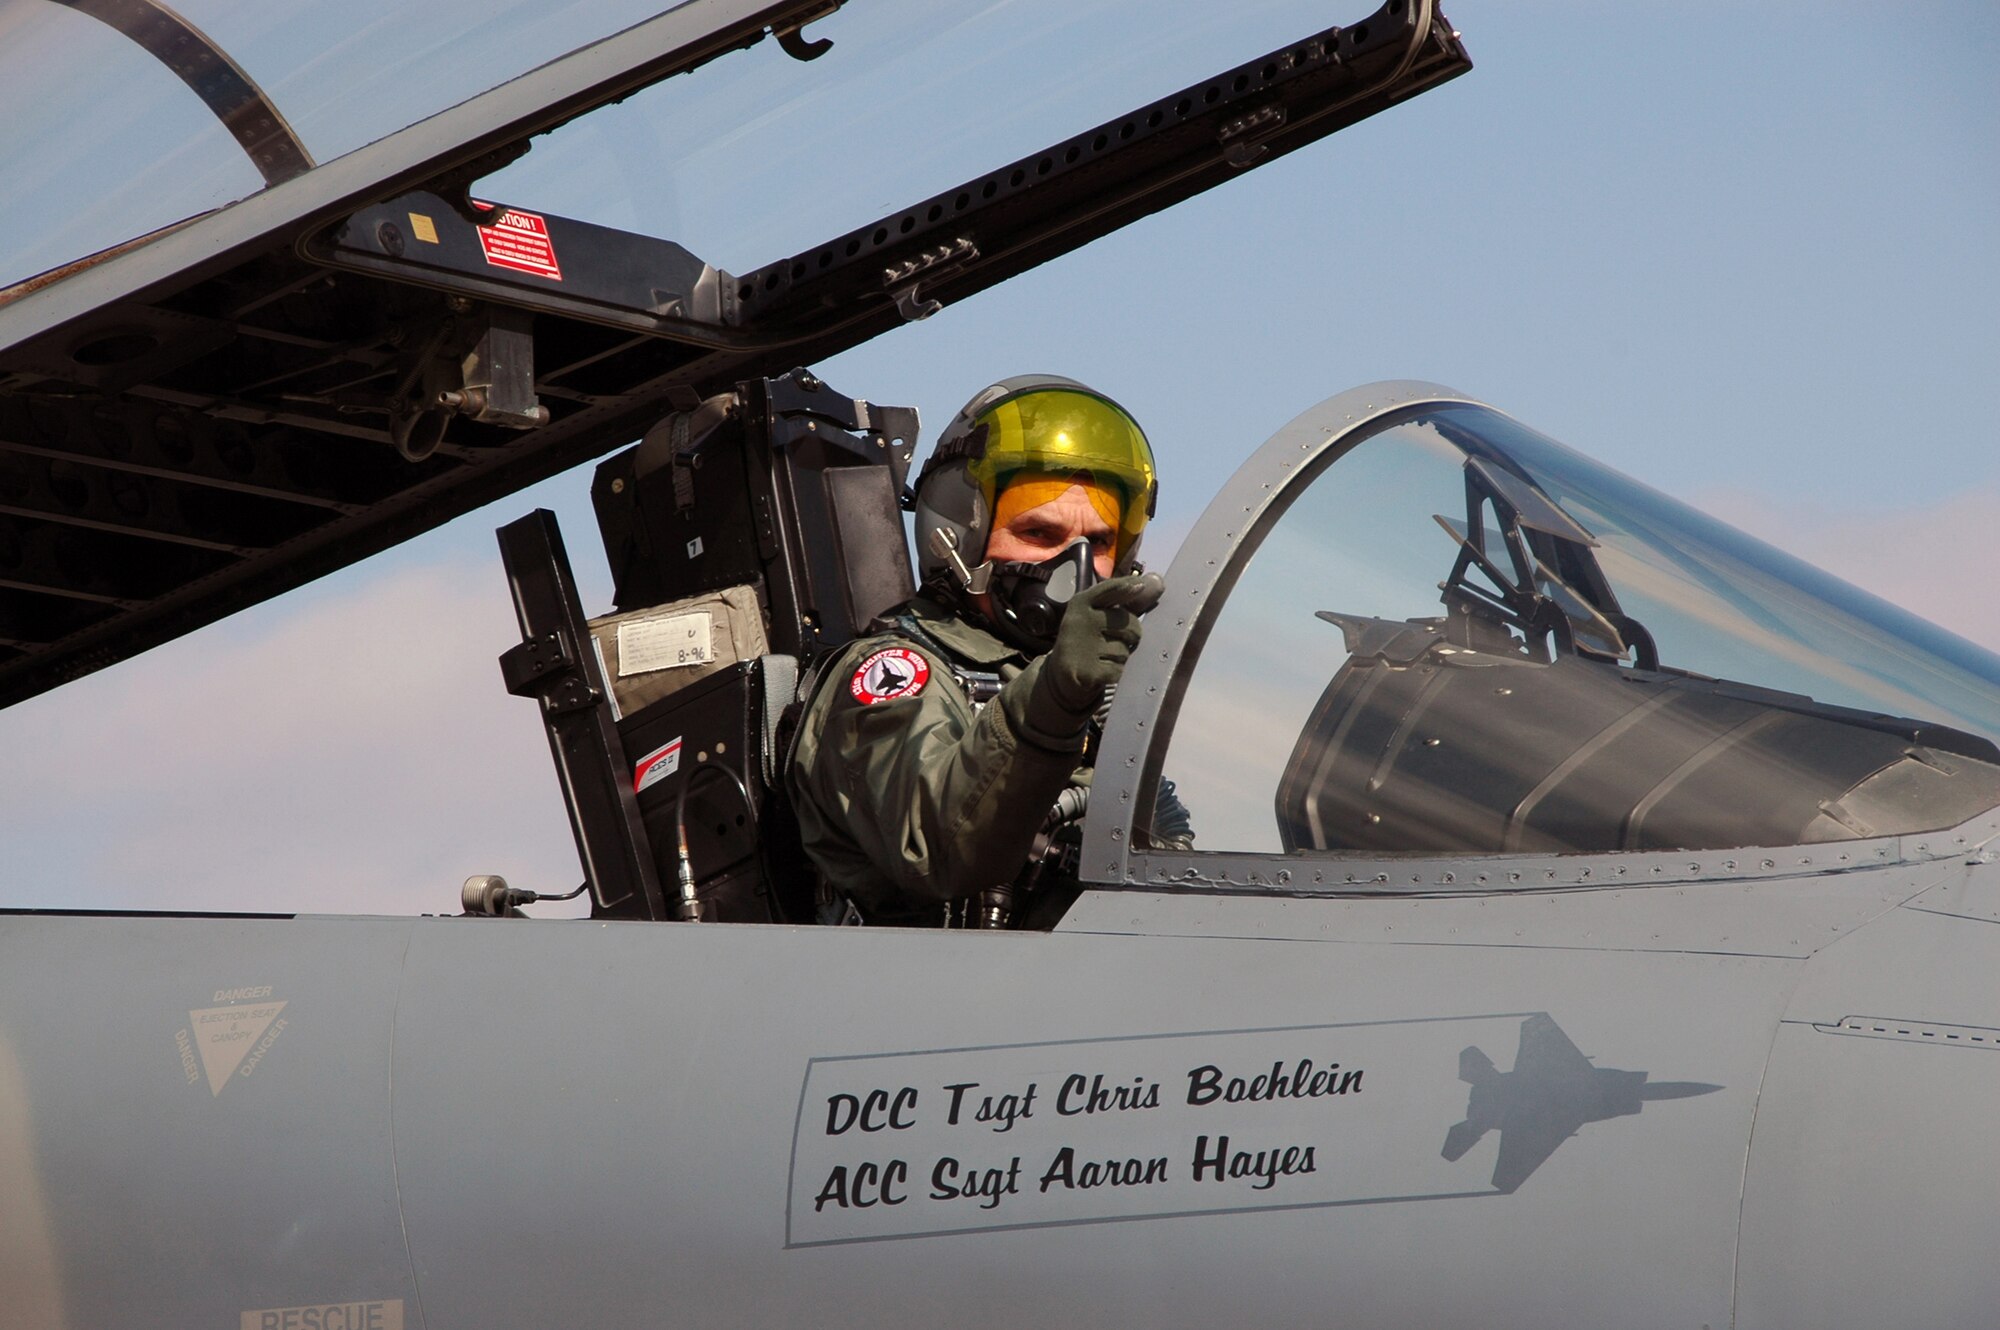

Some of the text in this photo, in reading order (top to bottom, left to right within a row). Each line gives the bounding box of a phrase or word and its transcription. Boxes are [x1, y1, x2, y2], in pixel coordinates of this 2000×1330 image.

[690, 540, 697, 556] 7
[678, 647, 705, 663] 8-96
[858, 649, 904, 673] FIGHTER
[907, 652, 927, 671] WING
[213, 985, 273, 1002] DANGER
[200, 1007, 276, 1024] EJECTION SEAT
[210, 1030, 252, 1044] CANOPY
[239, 1018, 289, 1078] DANGER
[174, 1027, 200, 1086] DANGER
[826, 1059, 1364, 1135] DCC Tsgt Chris Boehlein
[815, 1136, 1316, 1212] ACC Ssgt Aaron Hayes
[261, 1303, 384, 1330] RESCUE
